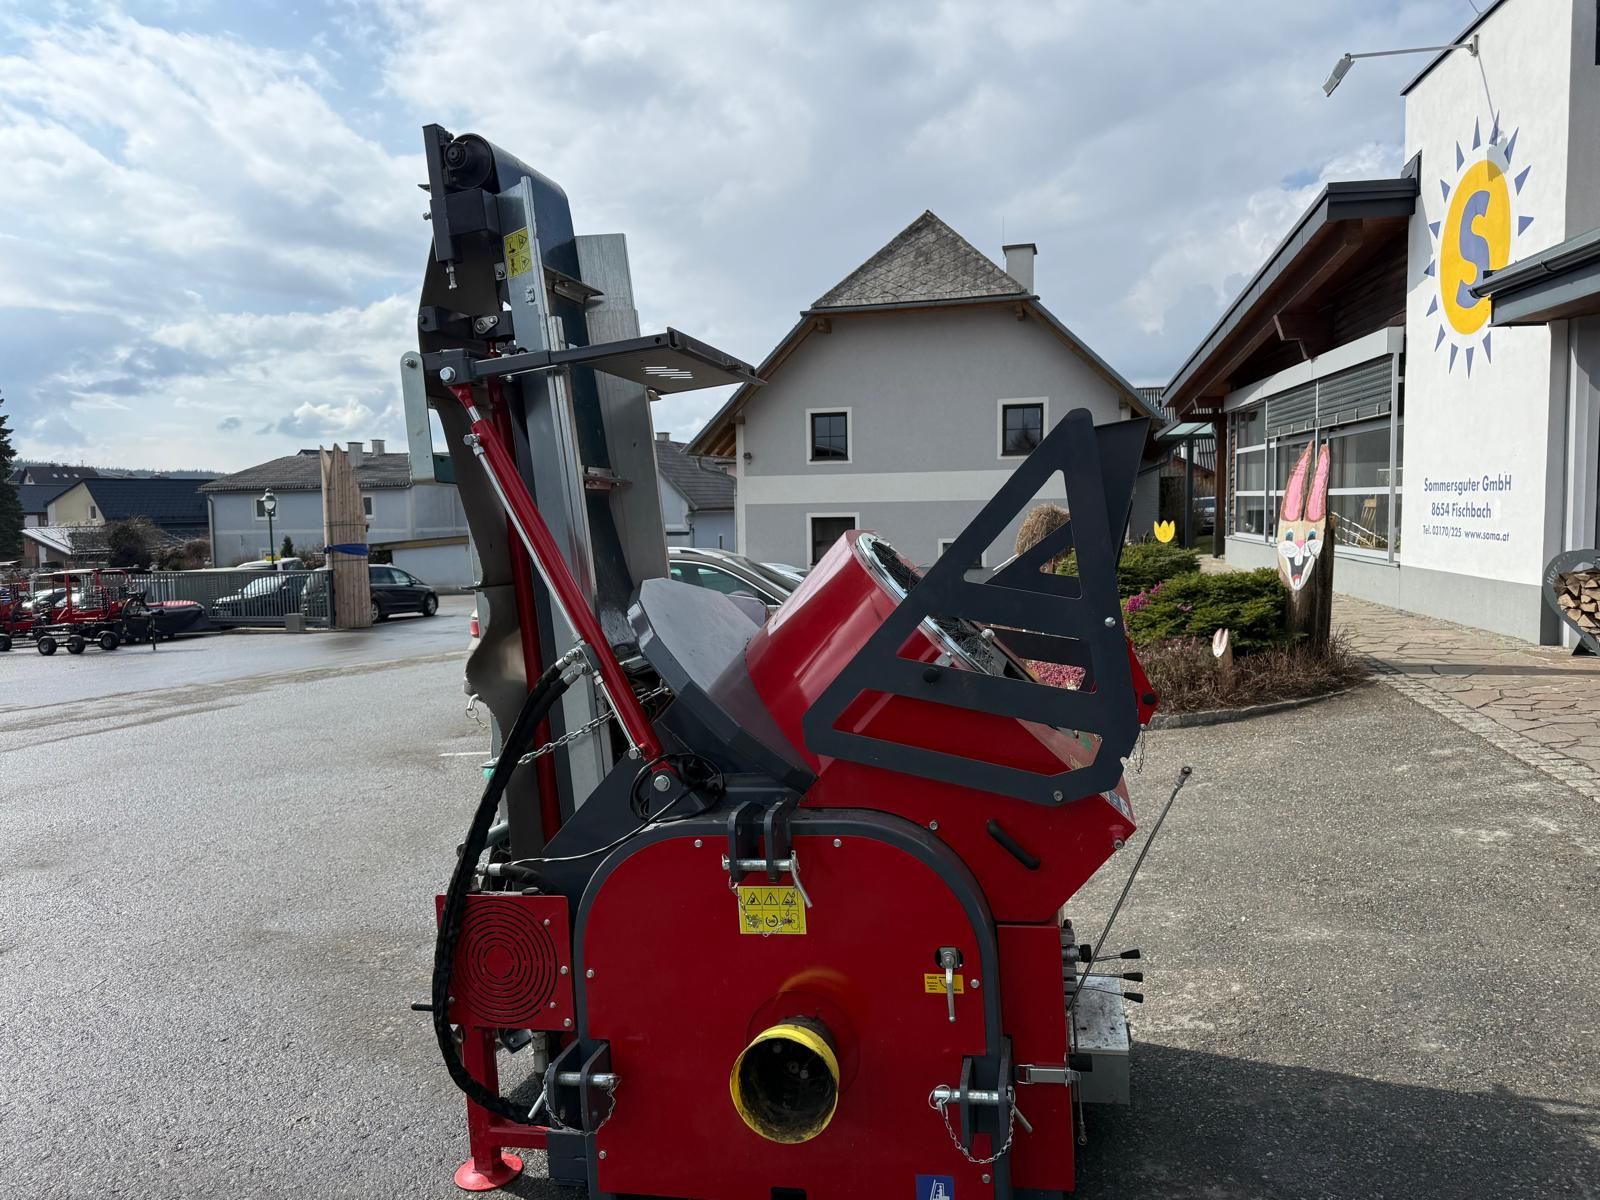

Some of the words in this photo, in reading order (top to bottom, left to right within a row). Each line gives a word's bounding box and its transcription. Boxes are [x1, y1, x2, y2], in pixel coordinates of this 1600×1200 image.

[1456, 190, 1490, 308] S
[1424, 477, 1480, 495] Sommersguter
[1482, 473, 1512, 492] GmbH
[1431, 502, 1450, 517] 8654
[1451, 502, 1491, 518] Fischbach
[1432, 525, 1462, 539] 03170/225
[1464, 530, 1510, 542] www.soma.at
